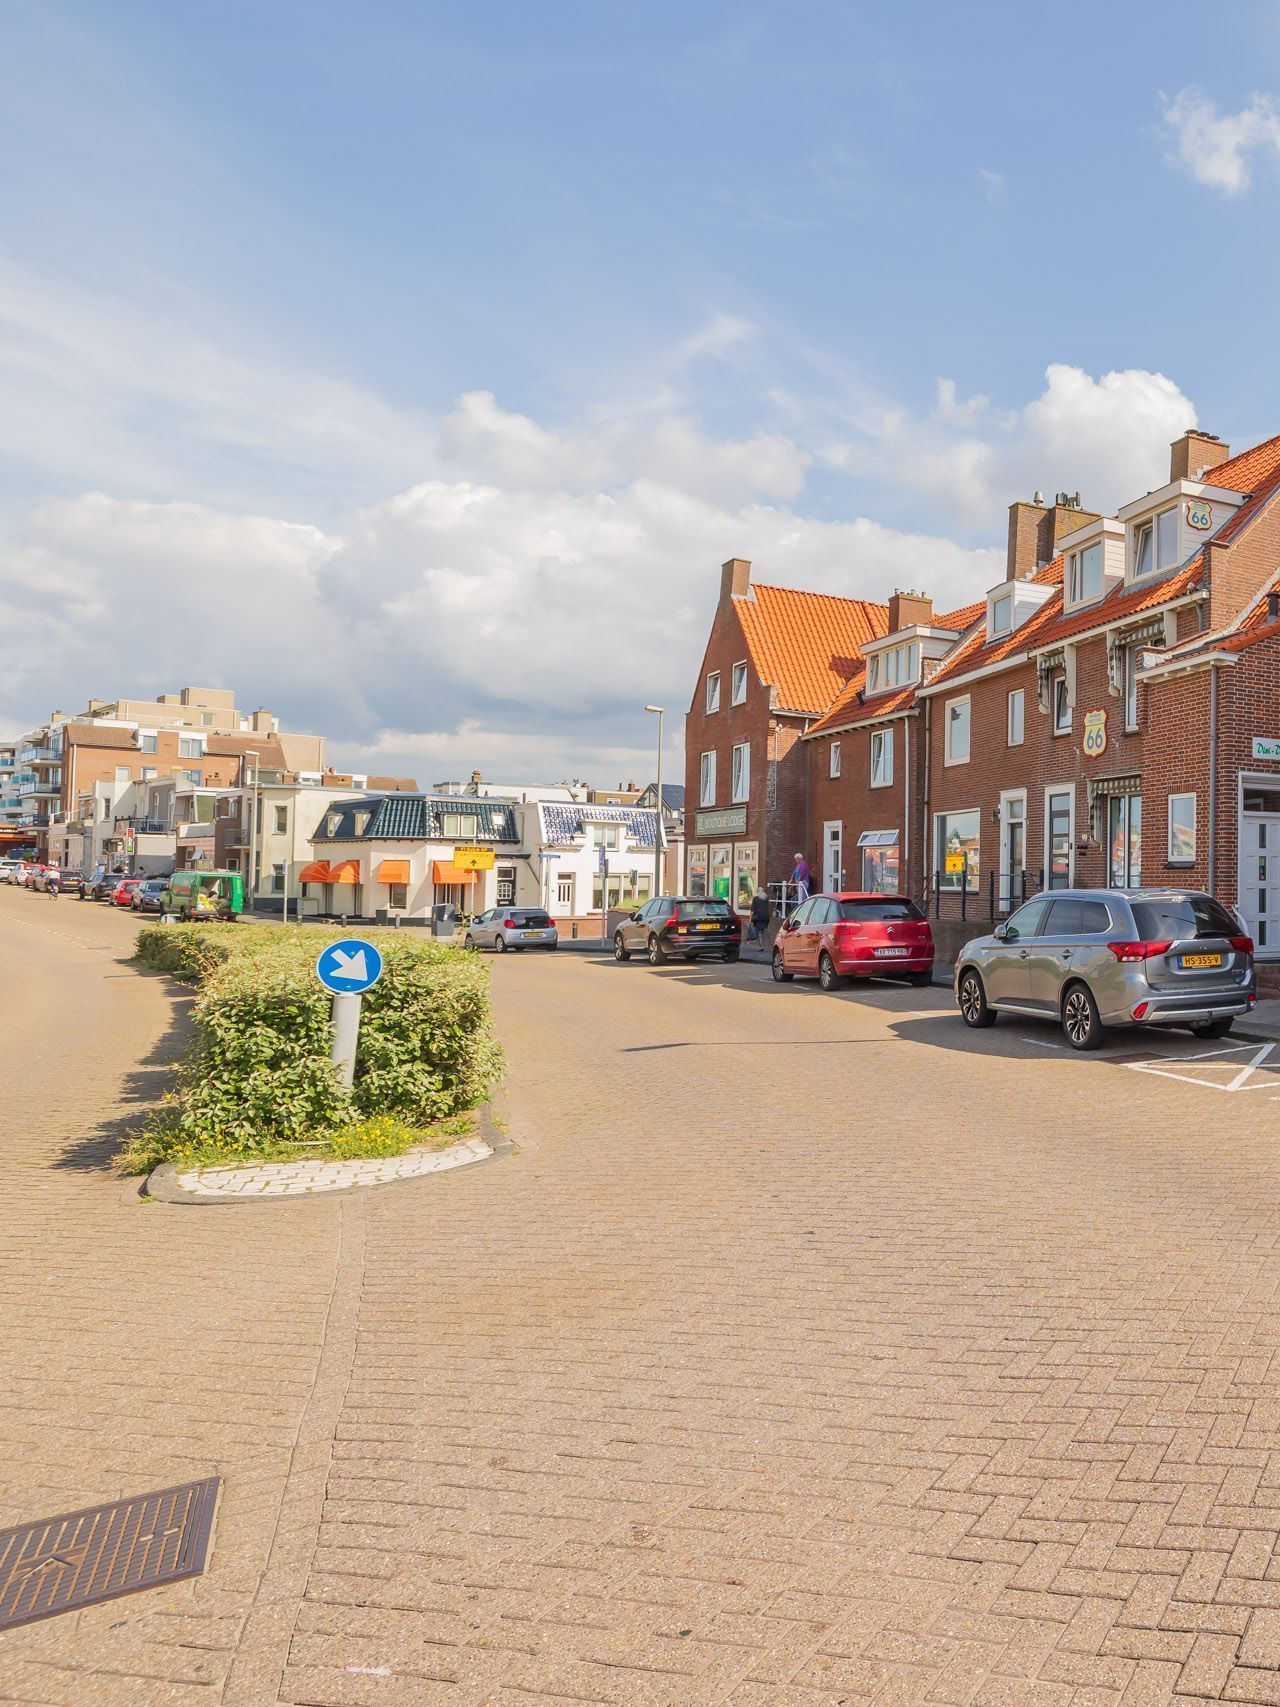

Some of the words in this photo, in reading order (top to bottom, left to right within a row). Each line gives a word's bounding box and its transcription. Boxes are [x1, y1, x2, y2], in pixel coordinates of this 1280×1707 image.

[1192, 512, 1208, 525] 66
[1086, 727, 1103, 750] 66
[705, 816, 727, 829] BOUTIQUE
[728, 815, 744, 827] LODGE
[1185, 956, 1219, 966] HS-355-V
